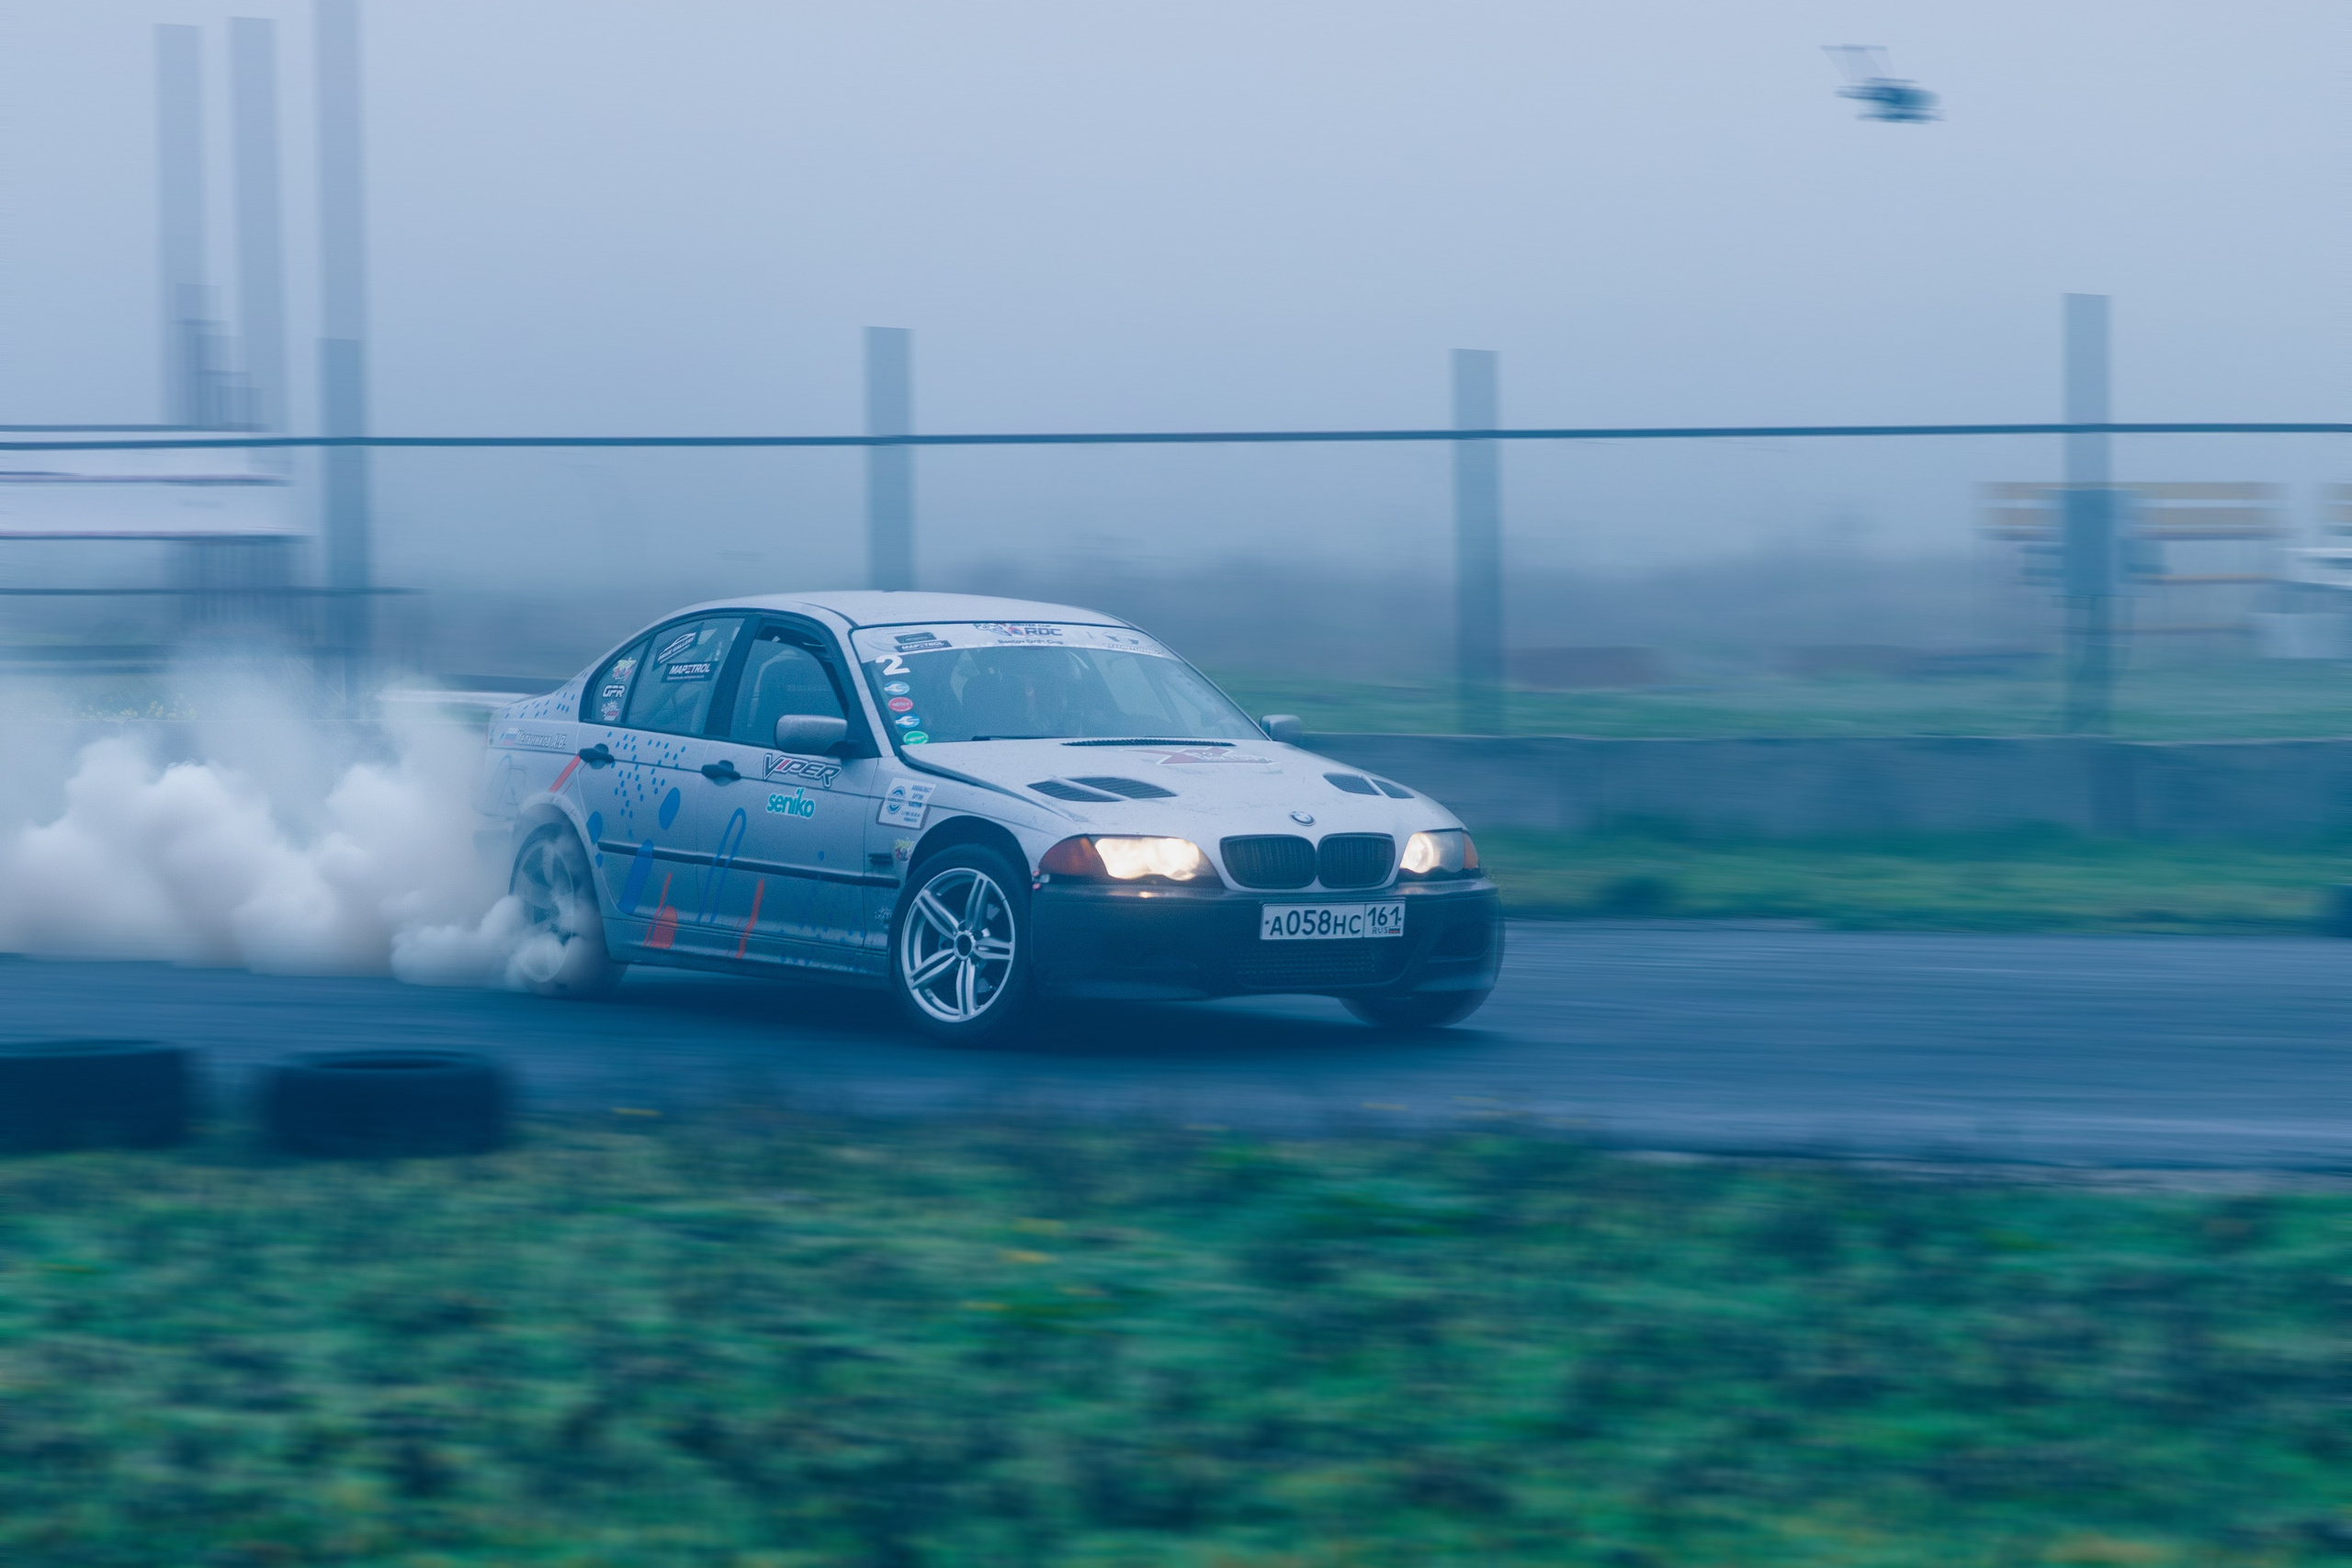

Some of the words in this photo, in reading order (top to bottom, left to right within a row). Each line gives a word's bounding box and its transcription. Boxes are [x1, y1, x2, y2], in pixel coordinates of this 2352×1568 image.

[1023, 627, 1063, 637] RDC
[669, 663, 710, 675] MAPETROL
[876, 654, 910, 675] 2
[603, 684, 625, 697] GPR
[763, 752, 842, 788] VIPER
[766, 787, 816, 819] seniko
[1367, 906, 1400, 927] 161
[1372, 926, 1389, 934] RUS
